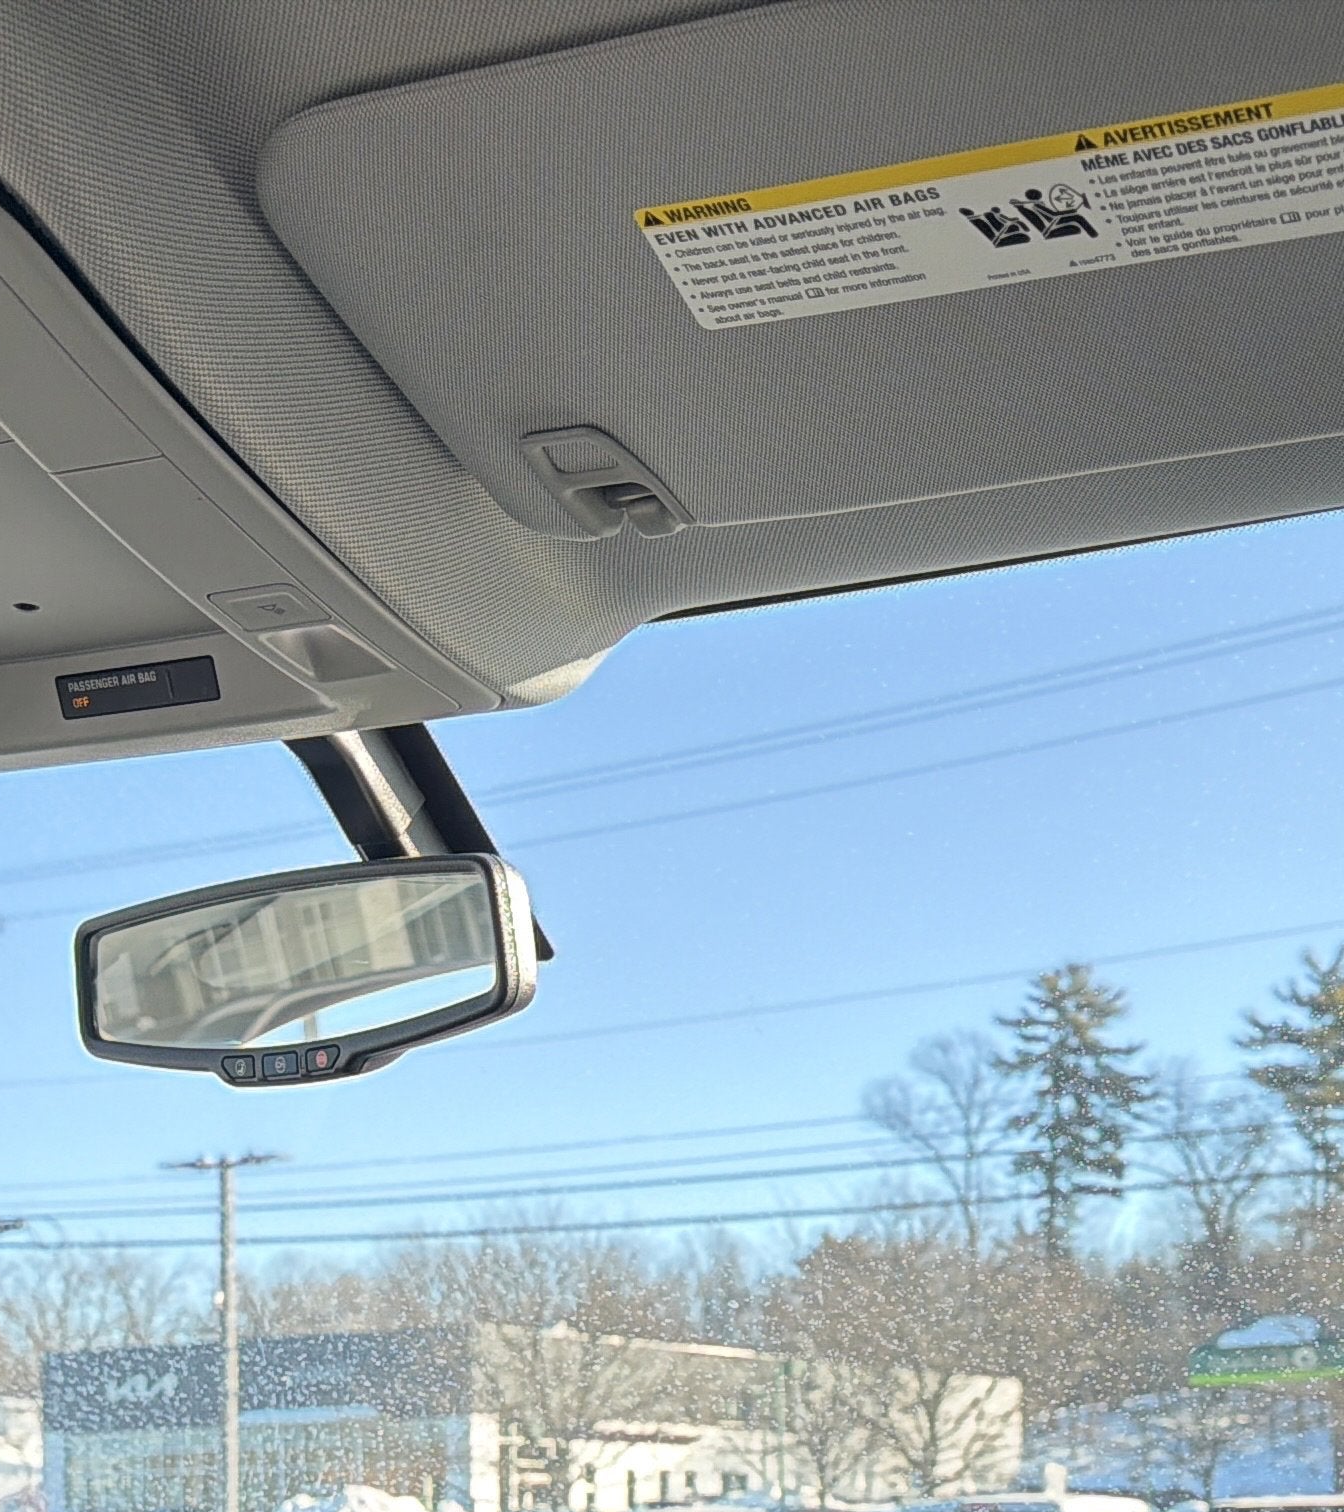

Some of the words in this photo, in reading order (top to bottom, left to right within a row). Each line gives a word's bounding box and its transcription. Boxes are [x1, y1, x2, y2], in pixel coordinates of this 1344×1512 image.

[1099, 103, 1276, 146] AVERTISSEMENT
[1079, 150, 1129, 171] MÊME
[1130, 145, 1173, 163] AVEC
[1174, 139, 1208, 155] DES
[1209, 130, 1254, 149] SACS
[653, 228, 700, 246] EVEN
[700, 220, 749, 238] WITH
[749, 203, 848, 230] ADVANCED
[850, 196, 885, 212] AIR
[887, 186, 941, 206] BAGS
[663, 196, 752, 223] WARNING
[674, 245, 715, 259] Children
[715, 243, 735, 252] can
[734, 239, 749, 249] be
[748, 234, 777, 246] killed
[777, 234, 788, 242] or
[789, 224, 836, 241] seriously
[835, 218, 873, 233] injured
[871, 216, 888, 227] by
[887, 212, 906, 223] the
[905, 210, 922, 220] air
[922, 205, 948, 219] bag.
[682, 262, 703, 273] The
[701, 258, 728, 270] back
[726, 254, 750, 265] seat
[749, 252, 761, 262] is
[759, 249, 778, 260] the
[777, 244, 810, 257] safest
[809, 239, 839, 253] place
[838, 236, 855, 247] for
[854, 229, 901, 244] children.
[690, 275, 720, 287] Never
[719, 272, 739, 284] put
[745, 261, 801, 279] rear-facing
[799, 257, 826, 269] child
[825, 253, 850, 264] seat
[849, 251, 861, 260] in
[861, 248, 880, 258] the
[879, 243, 909, 255] front.
[698, 287, 736, 302] Always
[734, 286, 753, 294] use
[752, 280, 776, 291] seat
[775, 276, 801, 288] belts
[800, 273, 822, 284] and
[821, 269, 847, 280] child
[847, 260, 897, 276] restraints.
[706, 303, 728, 314] See
[726, 297, 767, 311] owner's
[765, 291, 804, 304] manual
[824, 285, 841, 295] for
[841, 282, 868, 292] more
[868, 271, 927, 288] information
[713, 314, 742, 324] about
[741, 311, 756, 320] air
[756, 307, 785, 319] bags.
[67, 675, 120, 693] PASSENGER
[121, 674, 136, 687] AIR
[138, 671, 157, 683] BAG
[72, 696, 90, 708] OFF
